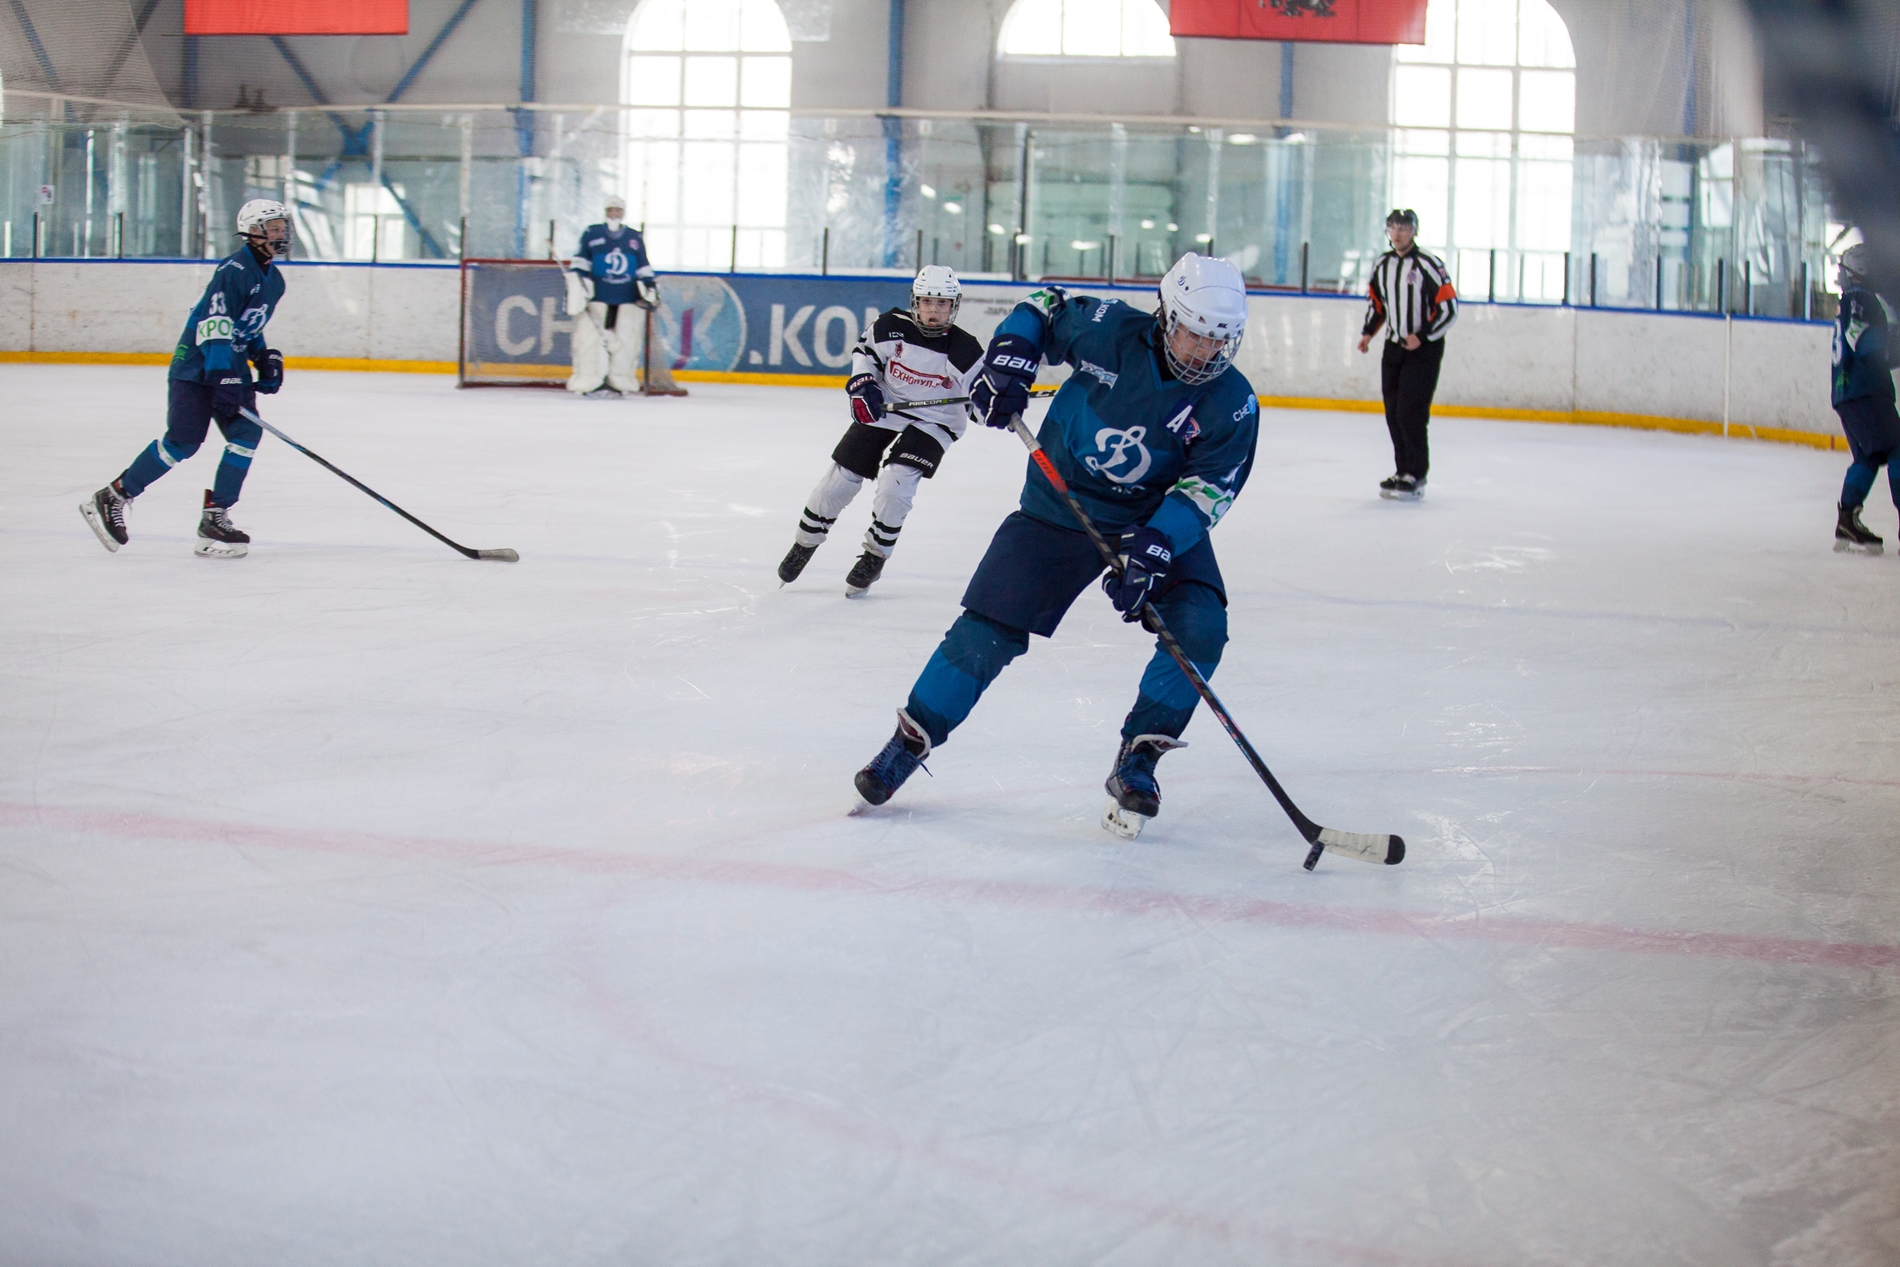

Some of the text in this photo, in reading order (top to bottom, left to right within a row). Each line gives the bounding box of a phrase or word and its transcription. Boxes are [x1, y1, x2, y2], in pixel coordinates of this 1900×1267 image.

[208, 291, 227, 315] 33
[198, 319, 235, 339] КРО
[992, 354, 1039, 374] BAU
[220, 377, 243, 385] BAU
[900, 452, 934, 469] BAUER
[1145, 543, 1172, 564] BA
